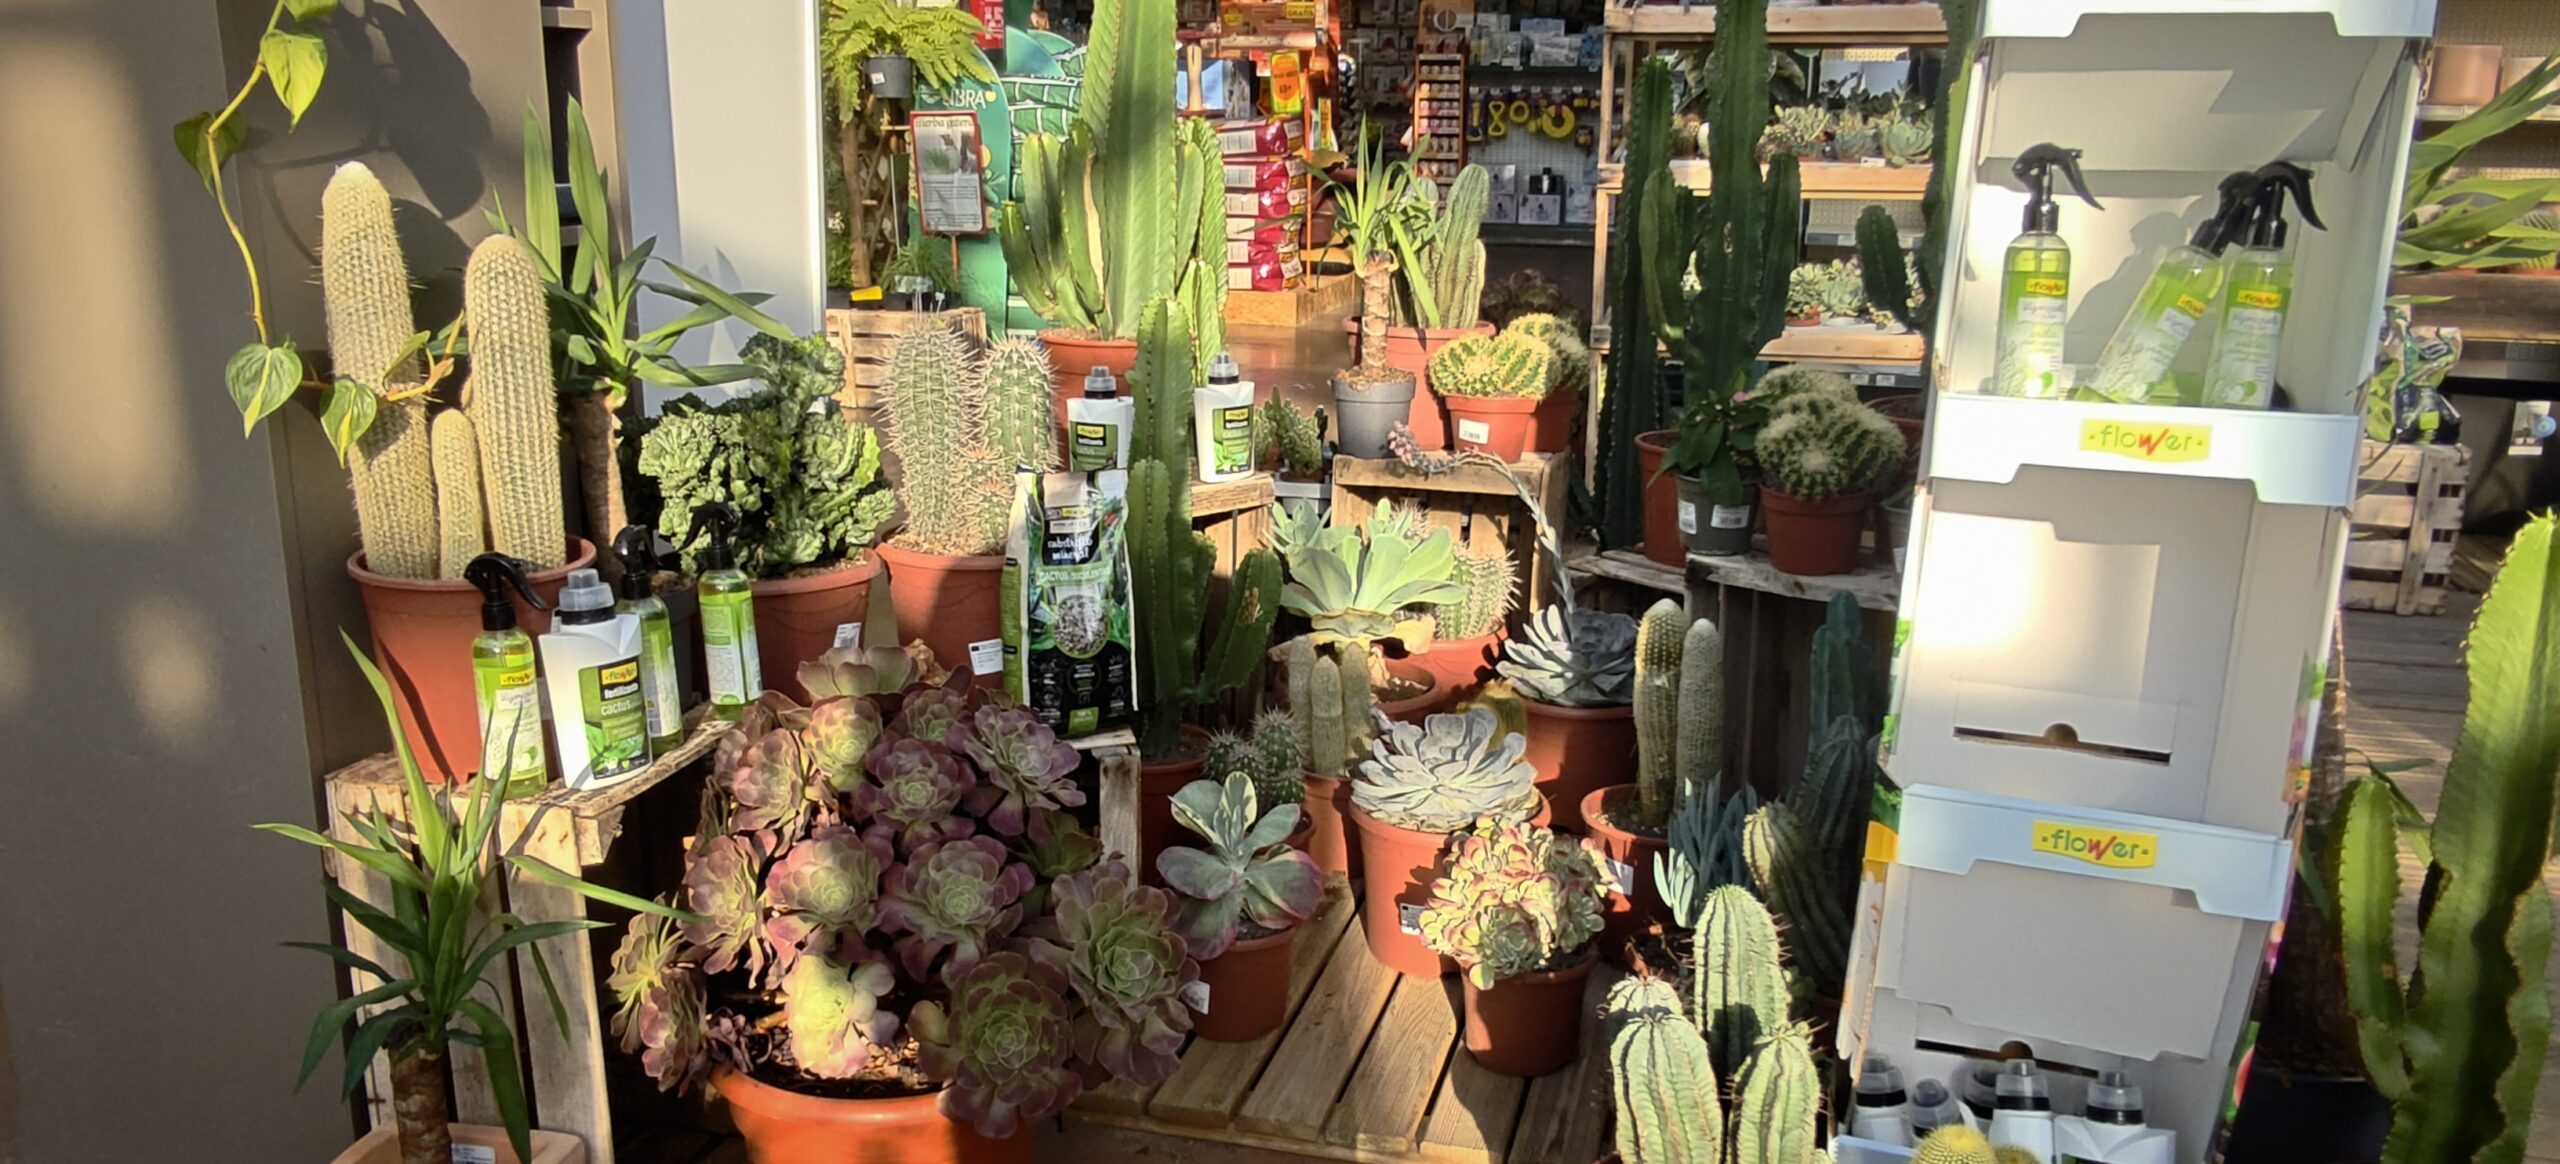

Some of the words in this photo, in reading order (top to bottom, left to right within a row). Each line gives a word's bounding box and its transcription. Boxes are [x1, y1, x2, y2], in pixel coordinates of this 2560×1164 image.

[2100, 425, 2193, 456] flower
[601, 700, 631, 716] cactus
[2051, 829, 2140, 861] flower
